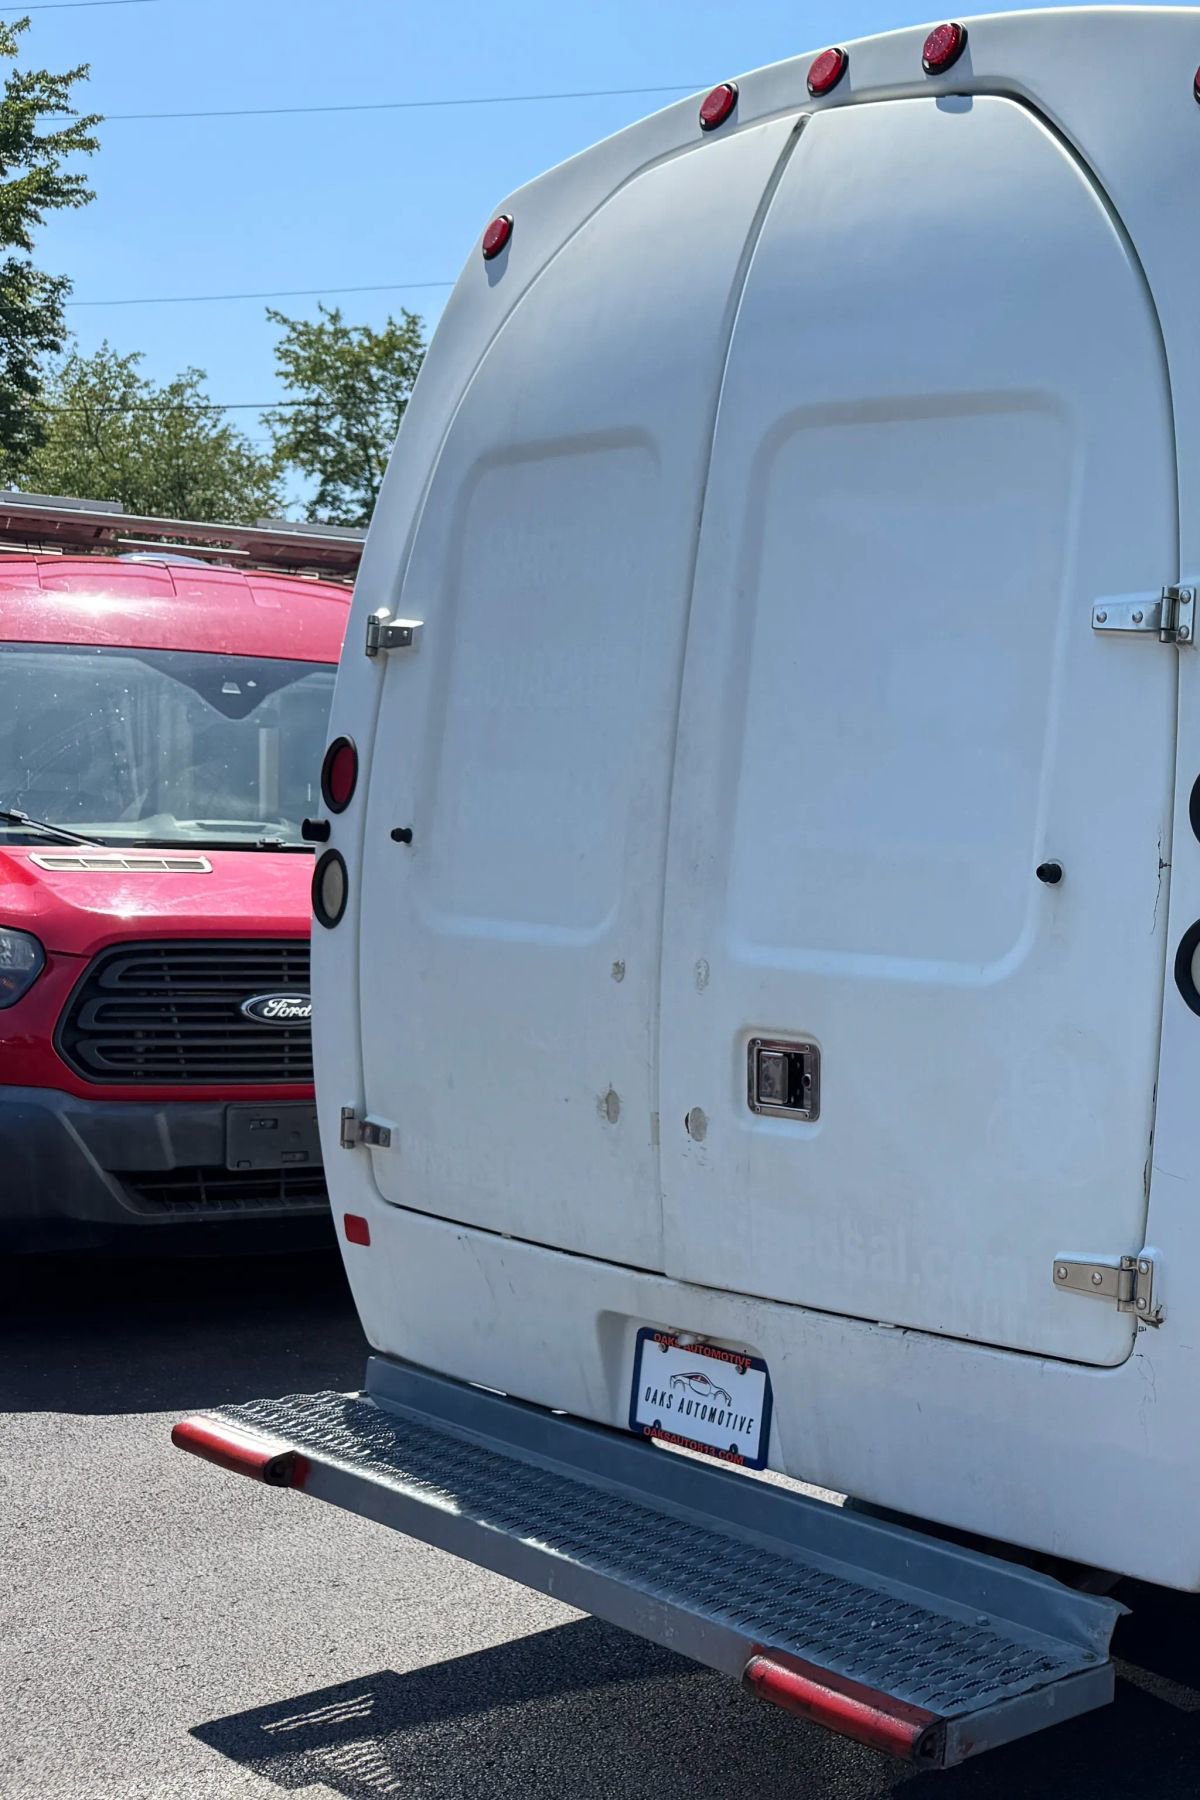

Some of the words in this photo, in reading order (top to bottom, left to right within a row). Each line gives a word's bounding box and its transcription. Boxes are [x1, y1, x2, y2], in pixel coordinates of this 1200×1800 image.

[263, 998, 312, 1017] Ford
[684, 1344, 752, 1368] AUTOMOTIVE
[645, 1386, 673, 1409] OAKS
[678, 1397, 754, 1435] AUTOMOTIVE
